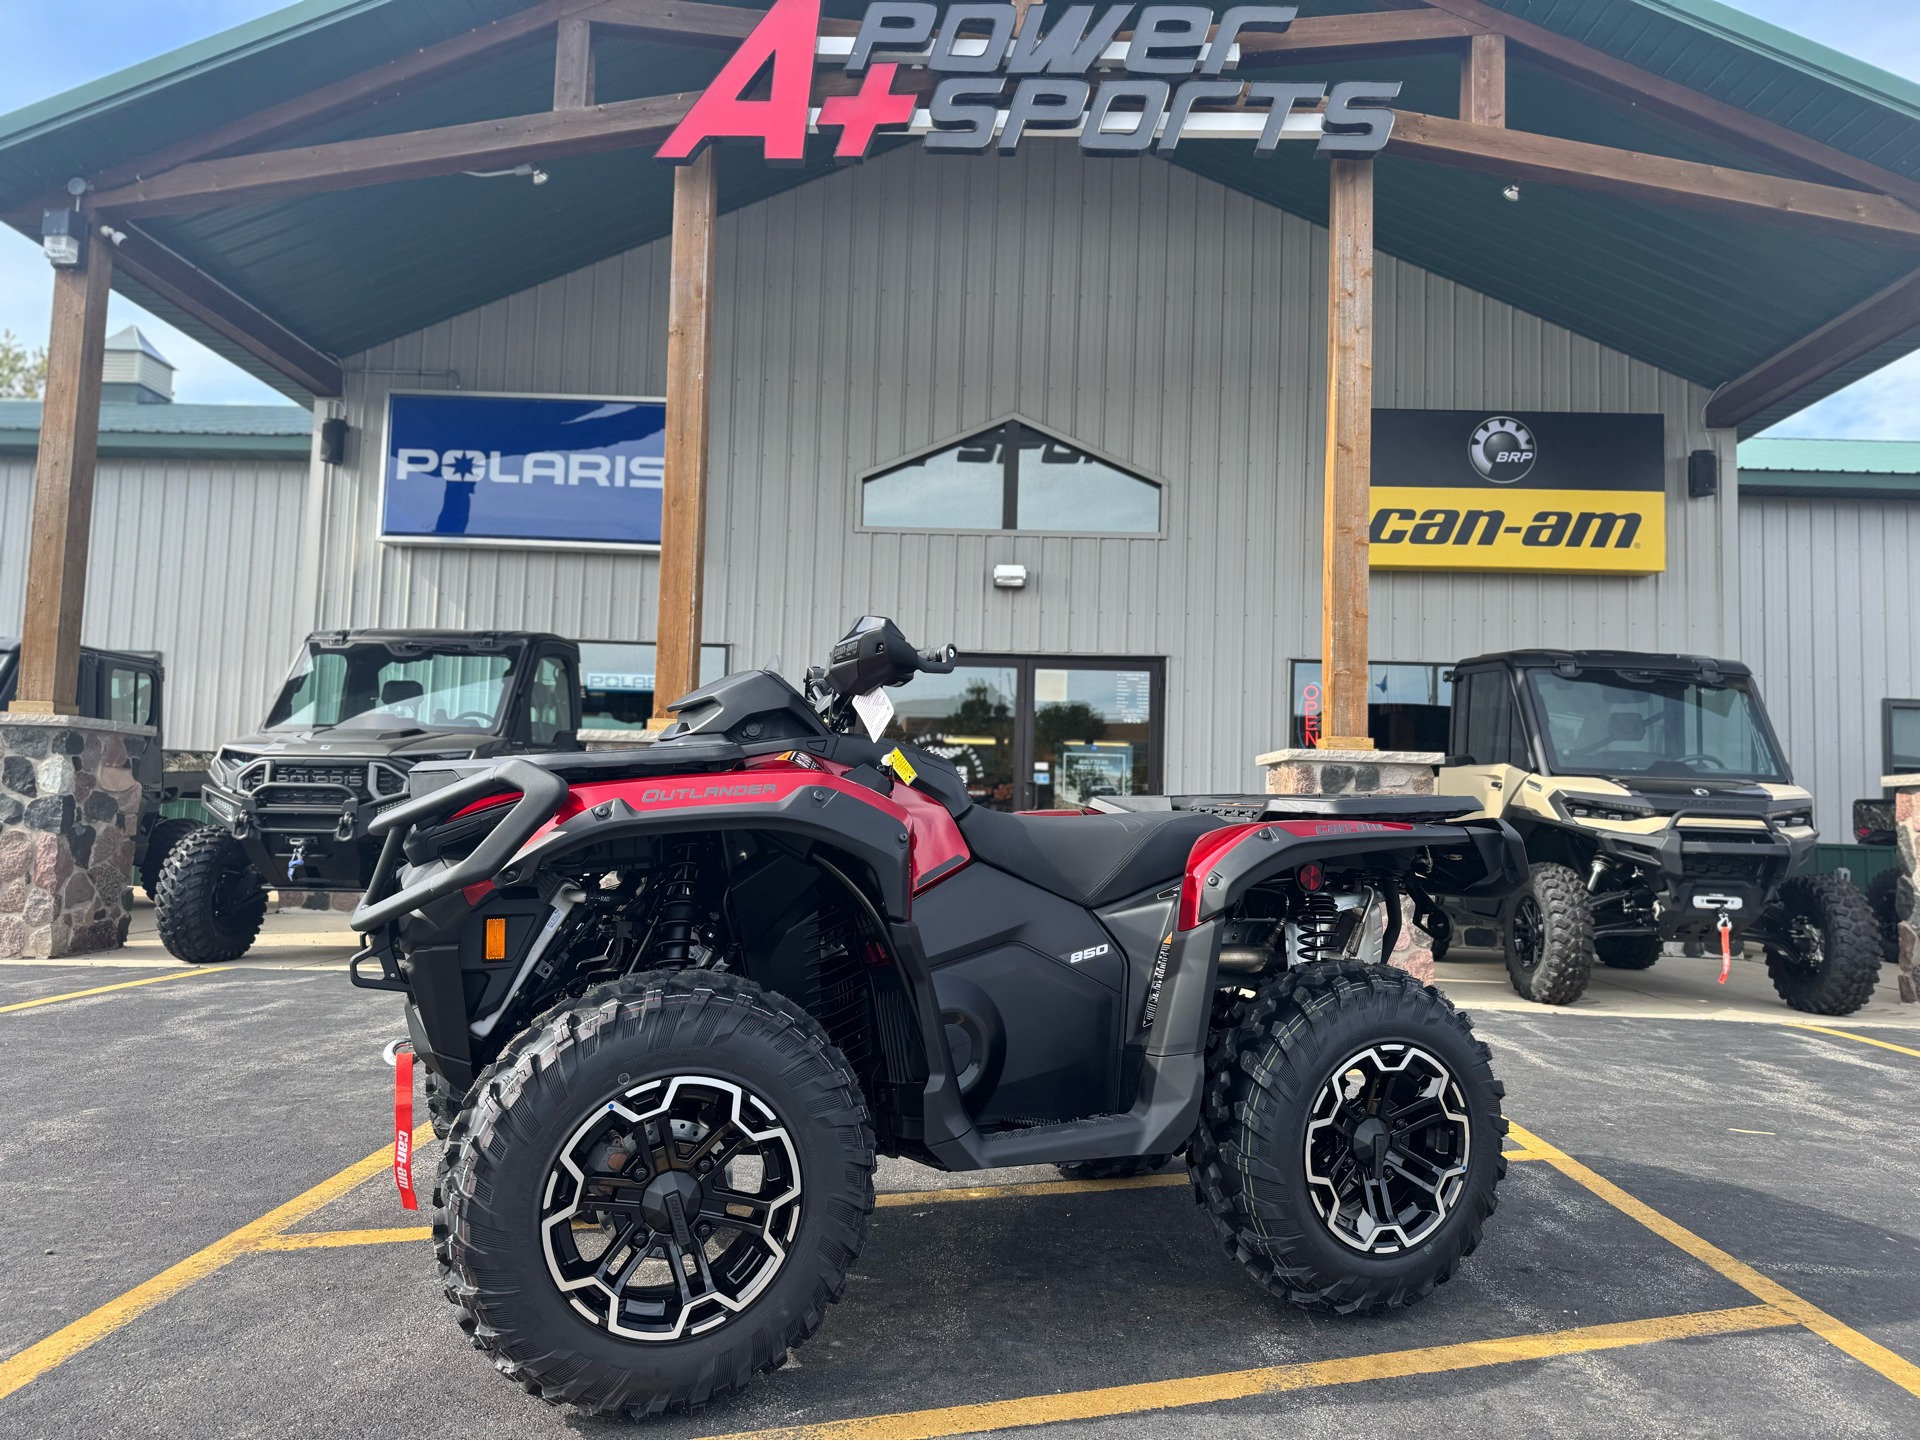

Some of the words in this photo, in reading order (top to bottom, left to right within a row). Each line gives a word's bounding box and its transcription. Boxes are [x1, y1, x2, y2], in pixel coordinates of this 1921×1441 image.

[653, 0, 917, 167] A+
[396, 448, 666, 488] POLARIS
[1495, 451, 1534, 464] BRP
[1369, 507, 1643, 549] can-am
[1303, 684, 1320, 747] OPEN
[641, 783, 778, 803] OUTLANDER
[1315, 822, 1387, 835] can-am
[1070, 943, 1109, 964] 850
[396, 1129, 410, 1190] can-am
